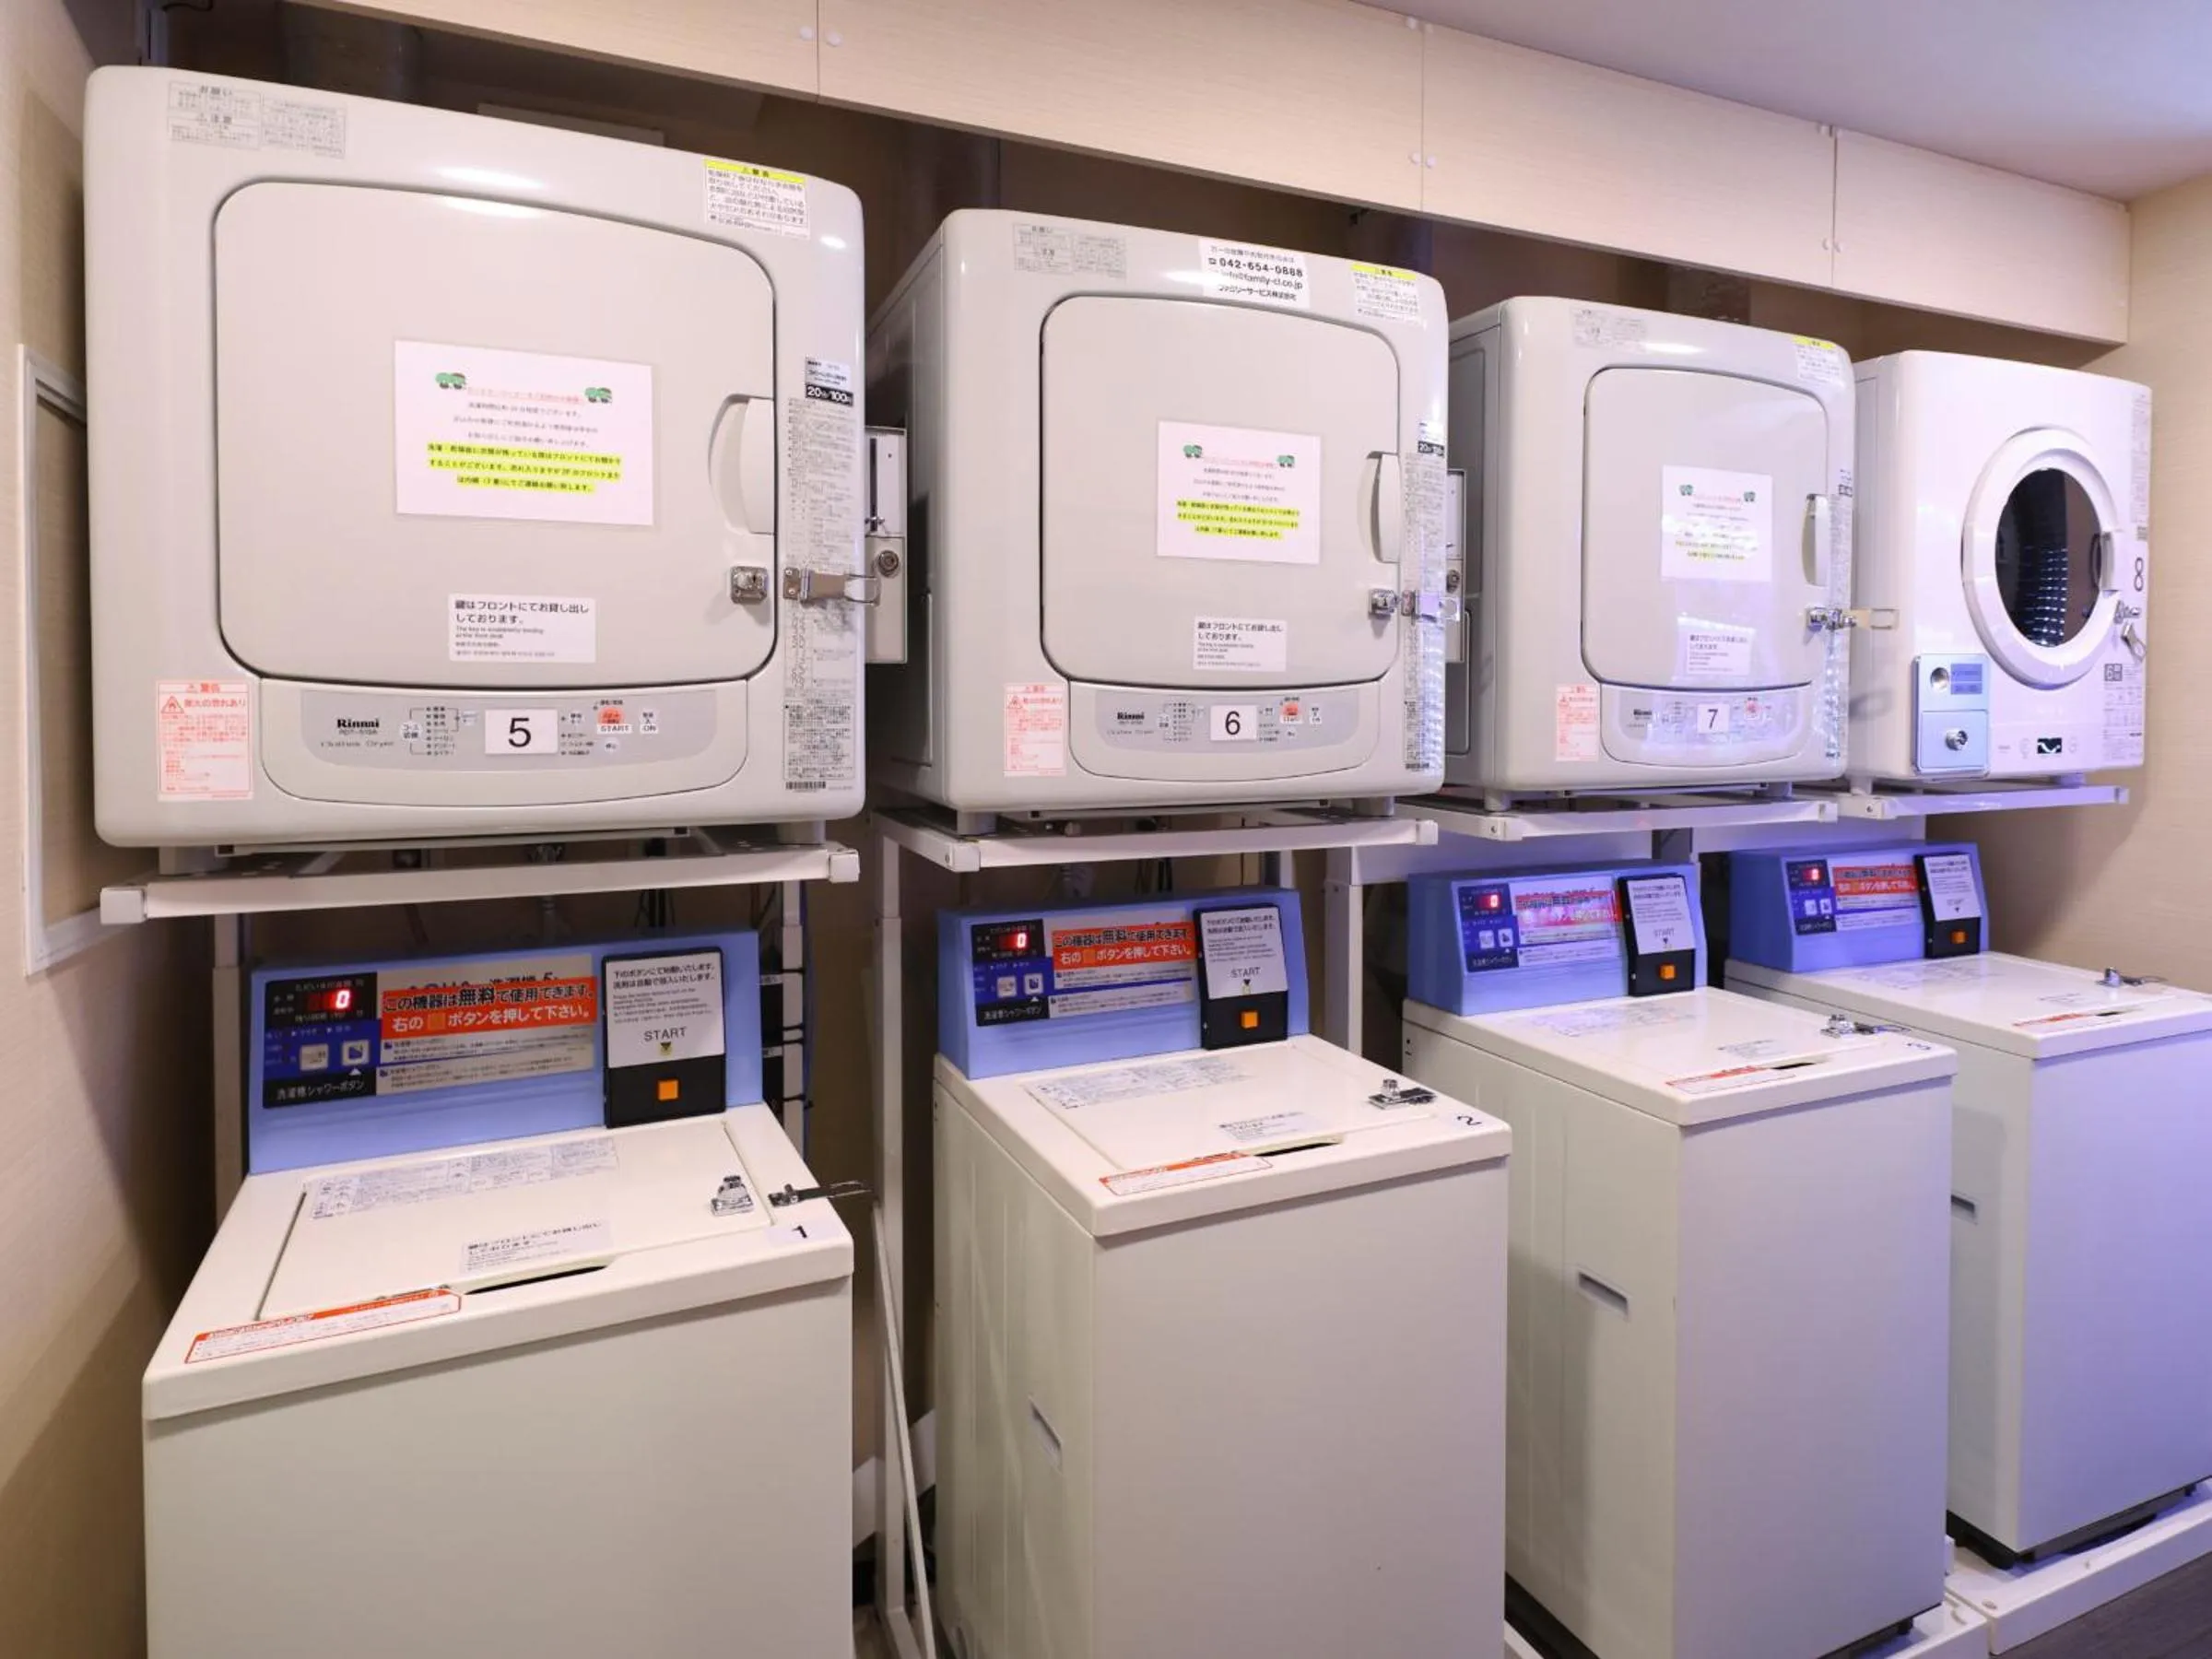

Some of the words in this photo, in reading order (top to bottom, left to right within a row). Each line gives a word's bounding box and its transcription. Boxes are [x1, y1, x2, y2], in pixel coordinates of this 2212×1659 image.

[2134, 557, 2144, 592] 8
[336, 718, 380, 728] Rinnai
[1225, 711, 1241, 735] 6
[1708, 709, 1719, 729] 7
[508, 717, 532, 747] 5
[1017, 933, 1027, 947] 0
[1231, 967, 1261, 978] START
[335, 990, 350, 1008] 0
[393, 1016, 424, 1032] 右の
[448, 1004, 590, 1027] ボタンを押して下さい。
[644, 1027, 688, 1041] START
[1456, 1115, 1483, 1126] 2
[793, 1225, 807, 1239] 1
